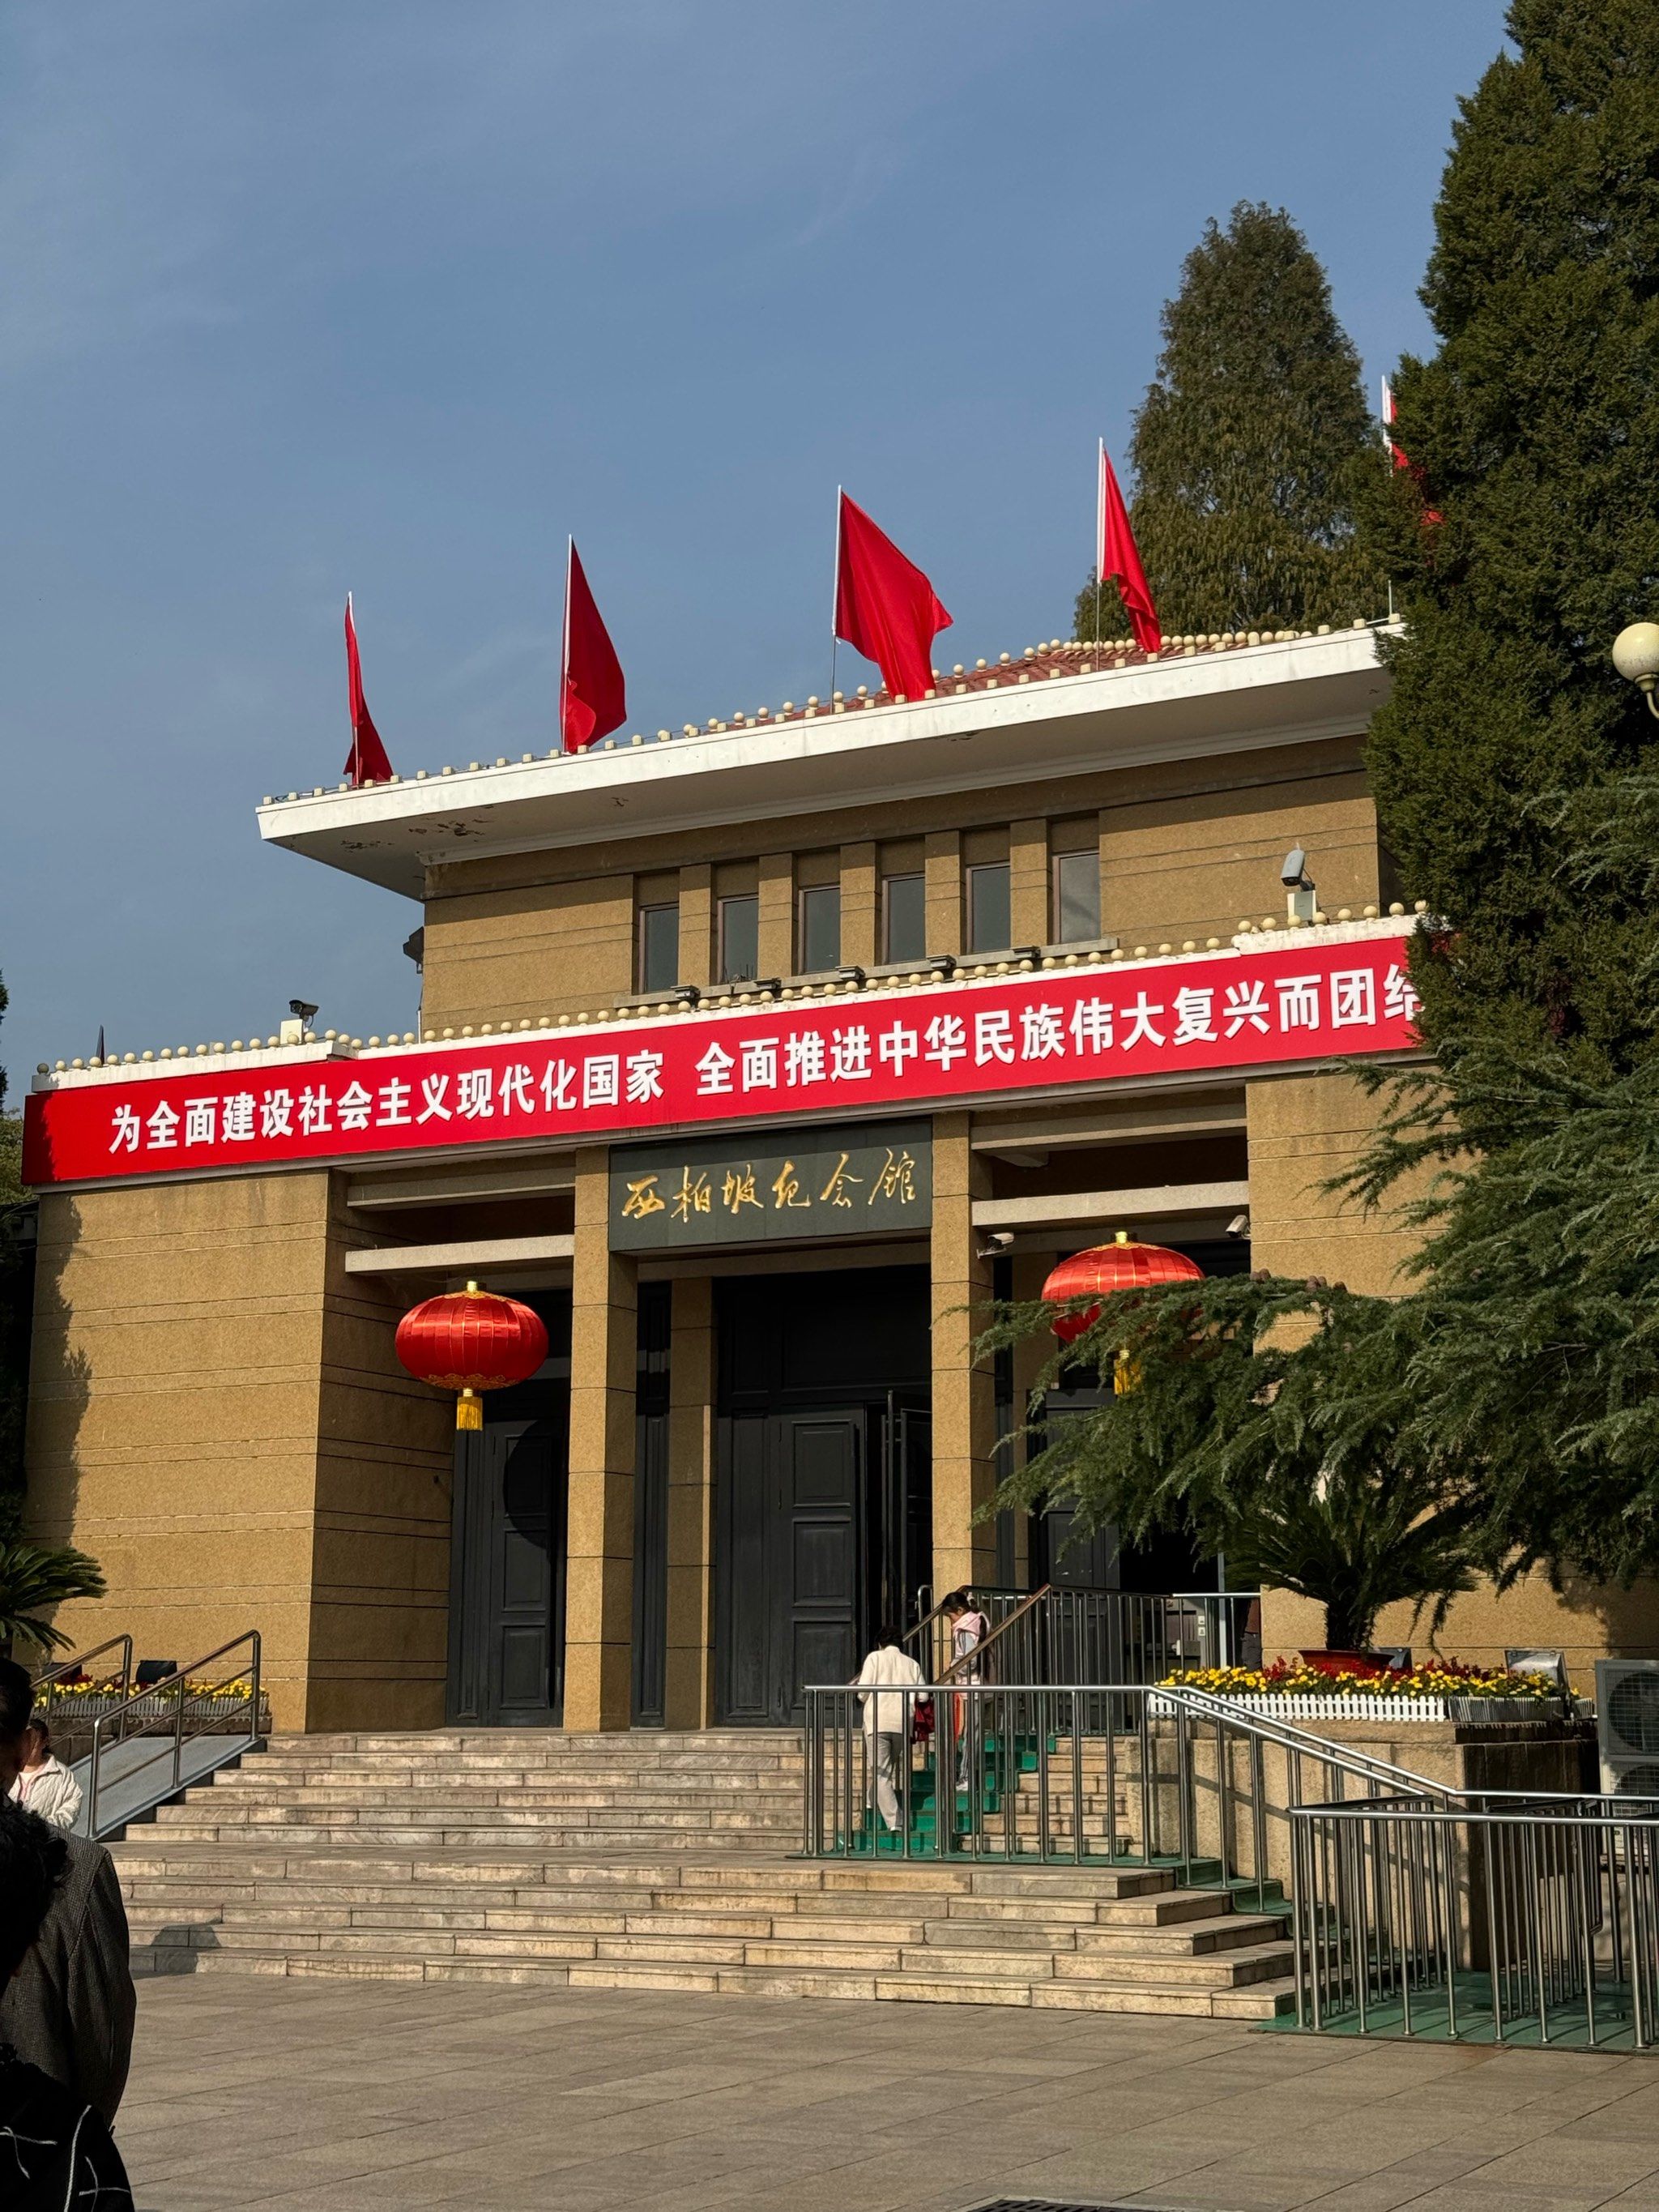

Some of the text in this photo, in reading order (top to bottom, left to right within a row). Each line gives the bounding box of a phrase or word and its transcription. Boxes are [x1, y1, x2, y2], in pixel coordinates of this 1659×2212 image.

[109, 1048, 664, 1154] 为全面建设社会主义现代化国家
